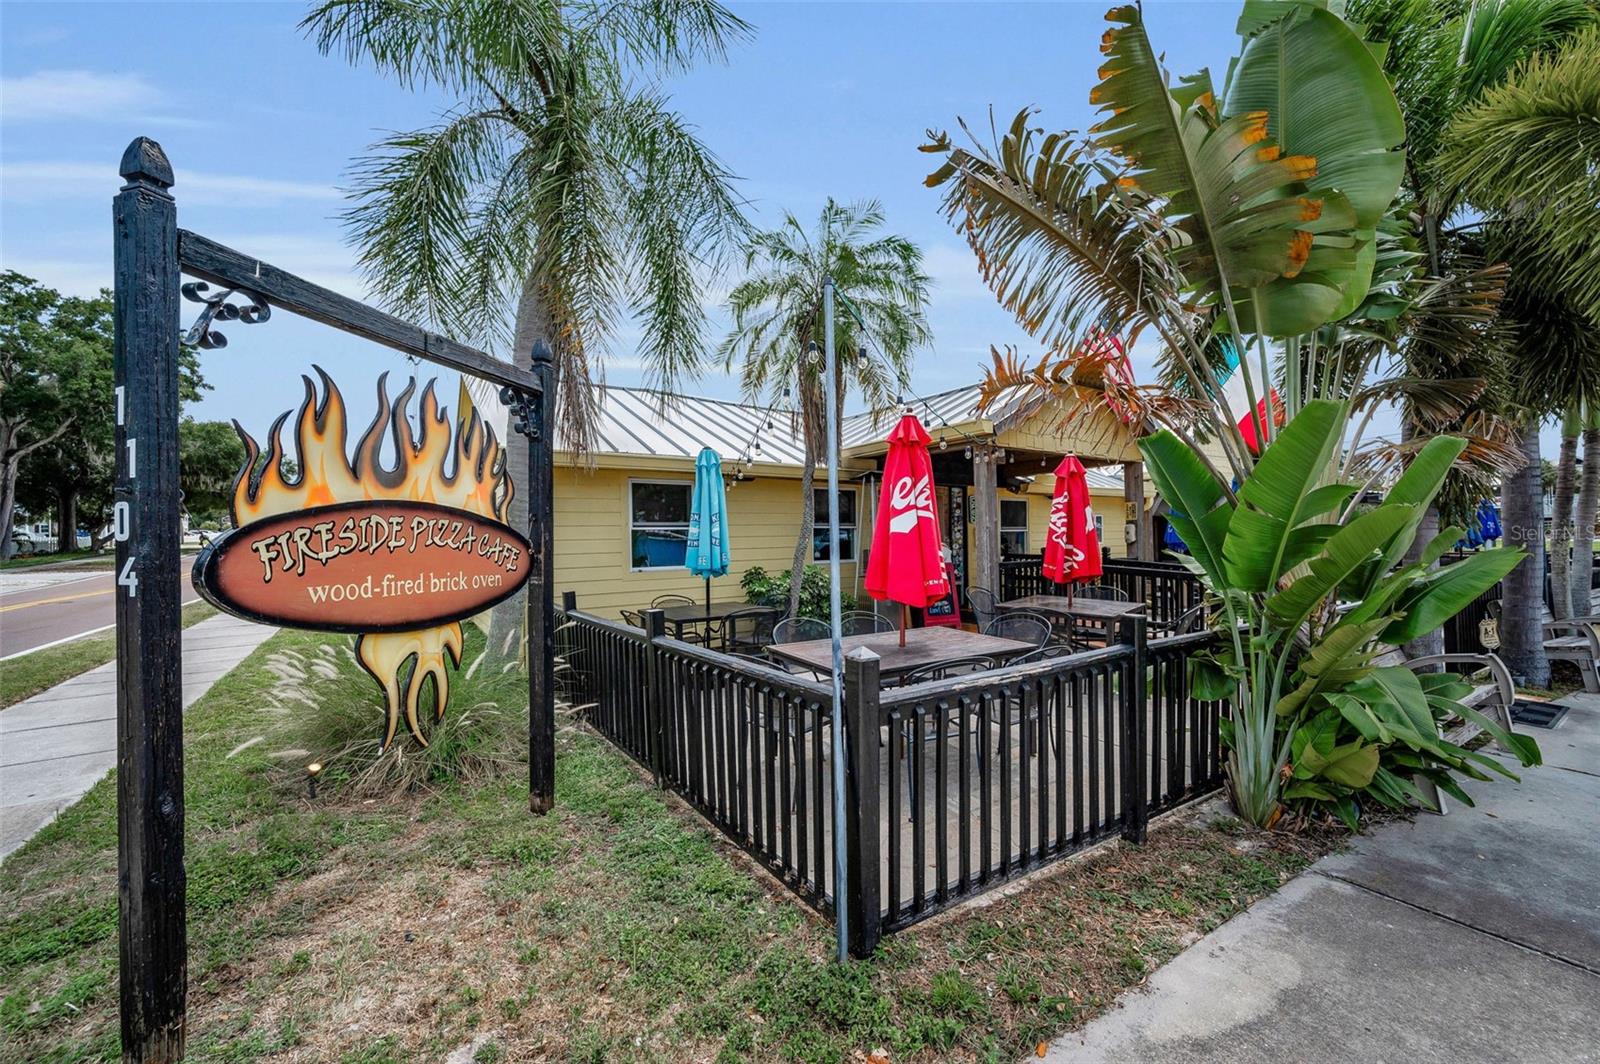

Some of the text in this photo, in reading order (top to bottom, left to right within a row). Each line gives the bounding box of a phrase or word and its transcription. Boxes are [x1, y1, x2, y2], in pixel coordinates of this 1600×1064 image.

[252, 514, 520, 582] FIRESIDE PIZZA CAFE
[307, 571, 502, 603] wood-fired brick oven
